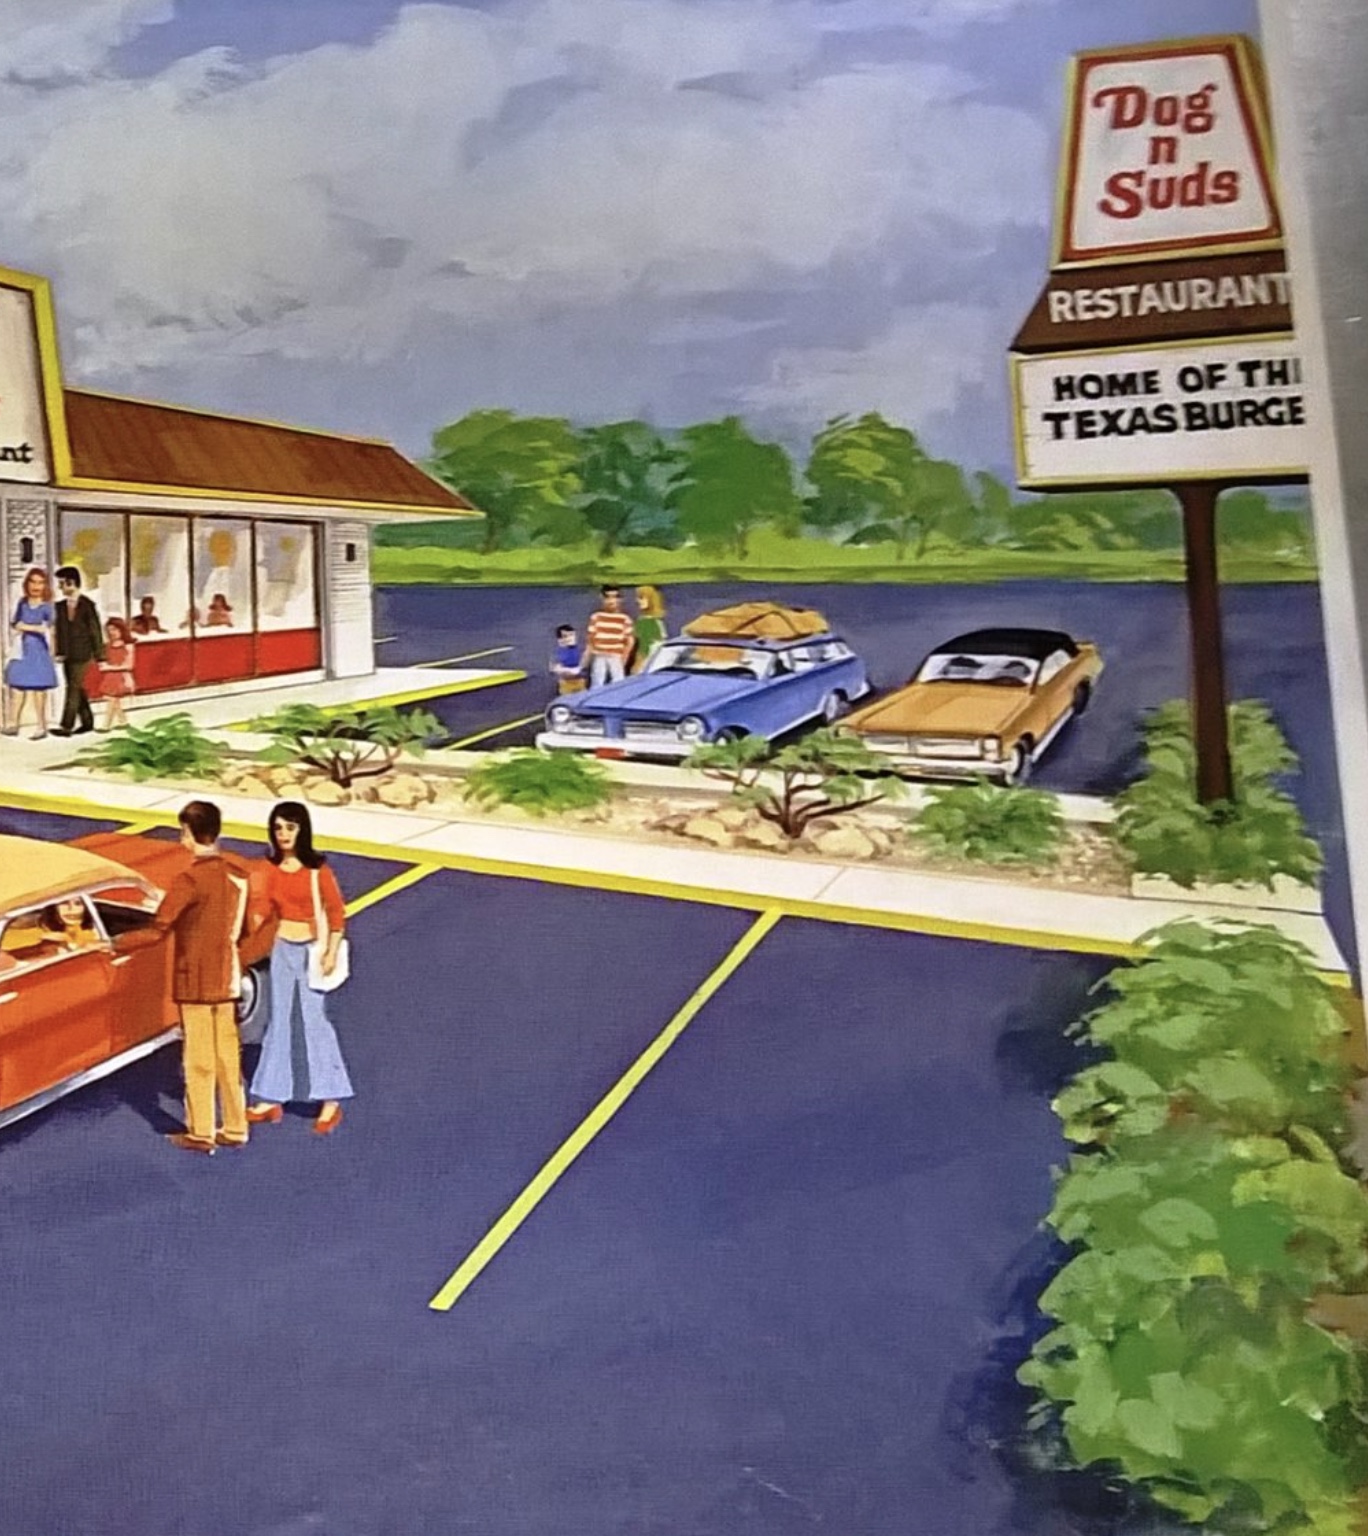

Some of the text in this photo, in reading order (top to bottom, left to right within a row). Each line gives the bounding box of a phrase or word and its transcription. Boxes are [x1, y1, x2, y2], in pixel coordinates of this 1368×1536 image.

[1091, 82, 1218, 134] Dog
[1148, 135, 1178, 165] n
[1097, 162, 1241, 219] Suds
[1049, 272, 1292, 323] RESTAURANT
[1053, 369, 1160, 401] HOME
[1178, 363, 1229, 392] OF
[1042, 396, 1305, 440] TEXAS BURGE
